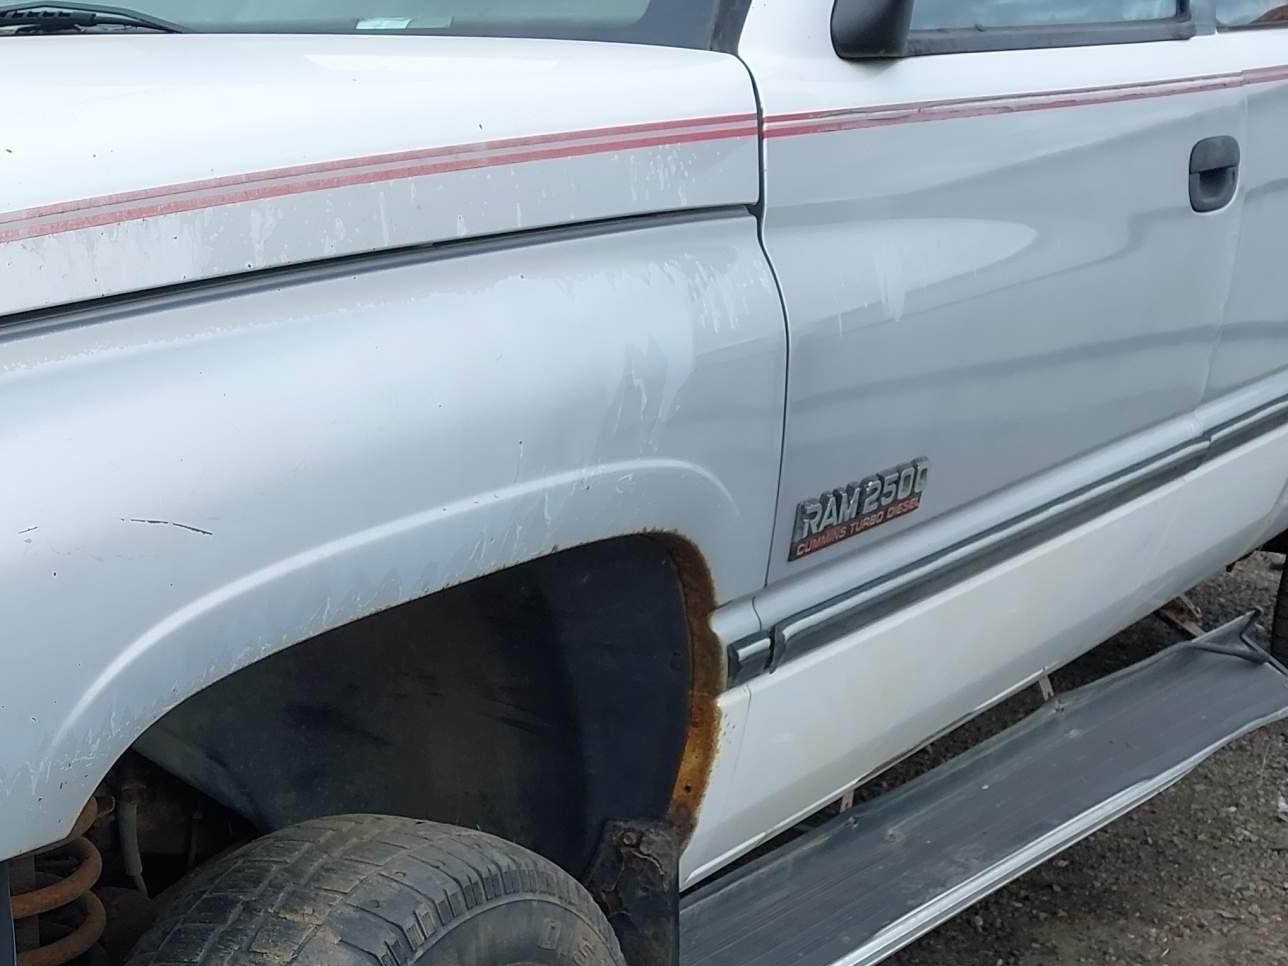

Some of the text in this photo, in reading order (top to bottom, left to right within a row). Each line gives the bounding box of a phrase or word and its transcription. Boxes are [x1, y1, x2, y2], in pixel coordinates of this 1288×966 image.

[801, 461, 929, 539] RAM 2500
[795, 526, 848, 556] CUMMINS
[849, 510, 885, 535] TURBO
